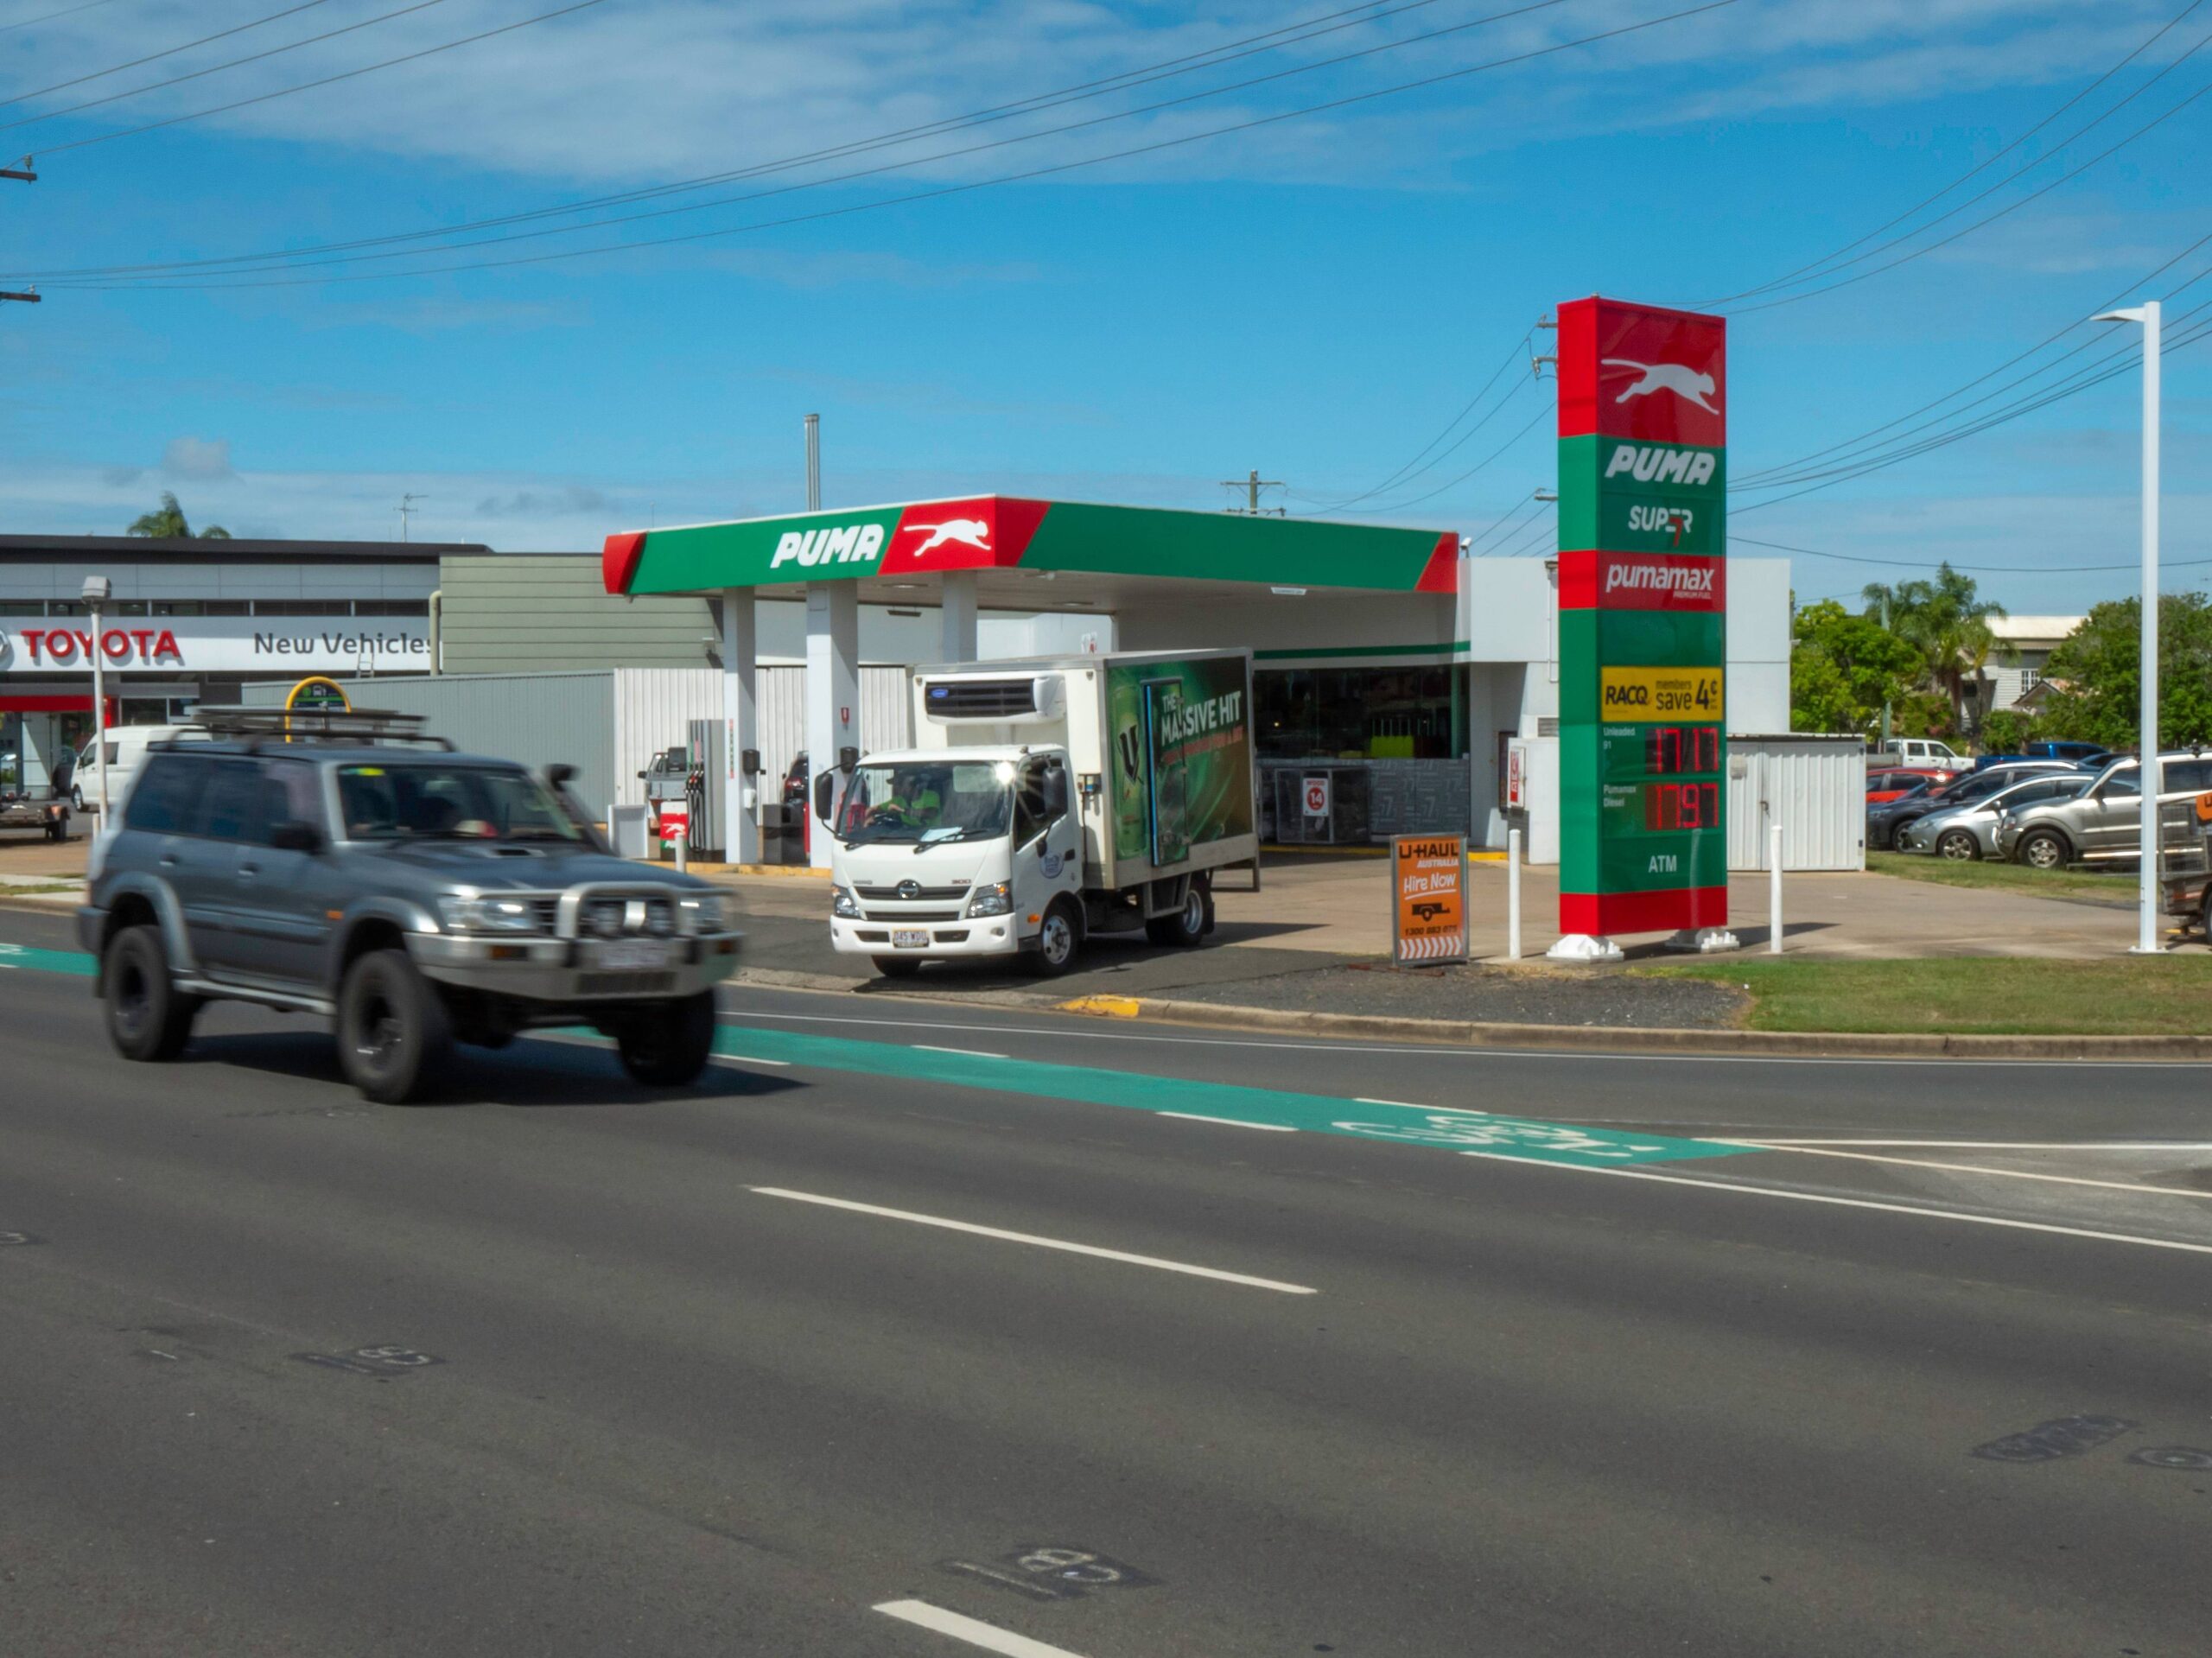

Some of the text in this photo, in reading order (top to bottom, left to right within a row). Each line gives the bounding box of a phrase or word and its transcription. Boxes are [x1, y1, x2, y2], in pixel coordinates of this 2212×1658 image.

[1605, 445, 1716, 486] PUMA
[770, 524, 885, 569] PUMA
[1605, 564, 1714, 593] pumamax
[21, 628, 181, 657] TOYOTA
[254, 632, 315, 654] New
[1162, 692, 1176, 713] THE
[1219, 690, 1242, 726] HIT
[1605, 685, 1649, 706] RACQ
[1656, 691, 1692, 710] save
[1417, 858, 1459, 869] AUSTRALIA
[1648, 854, 1677, 873] ATM
[1403, 872, 1457, 894] Hire Now
